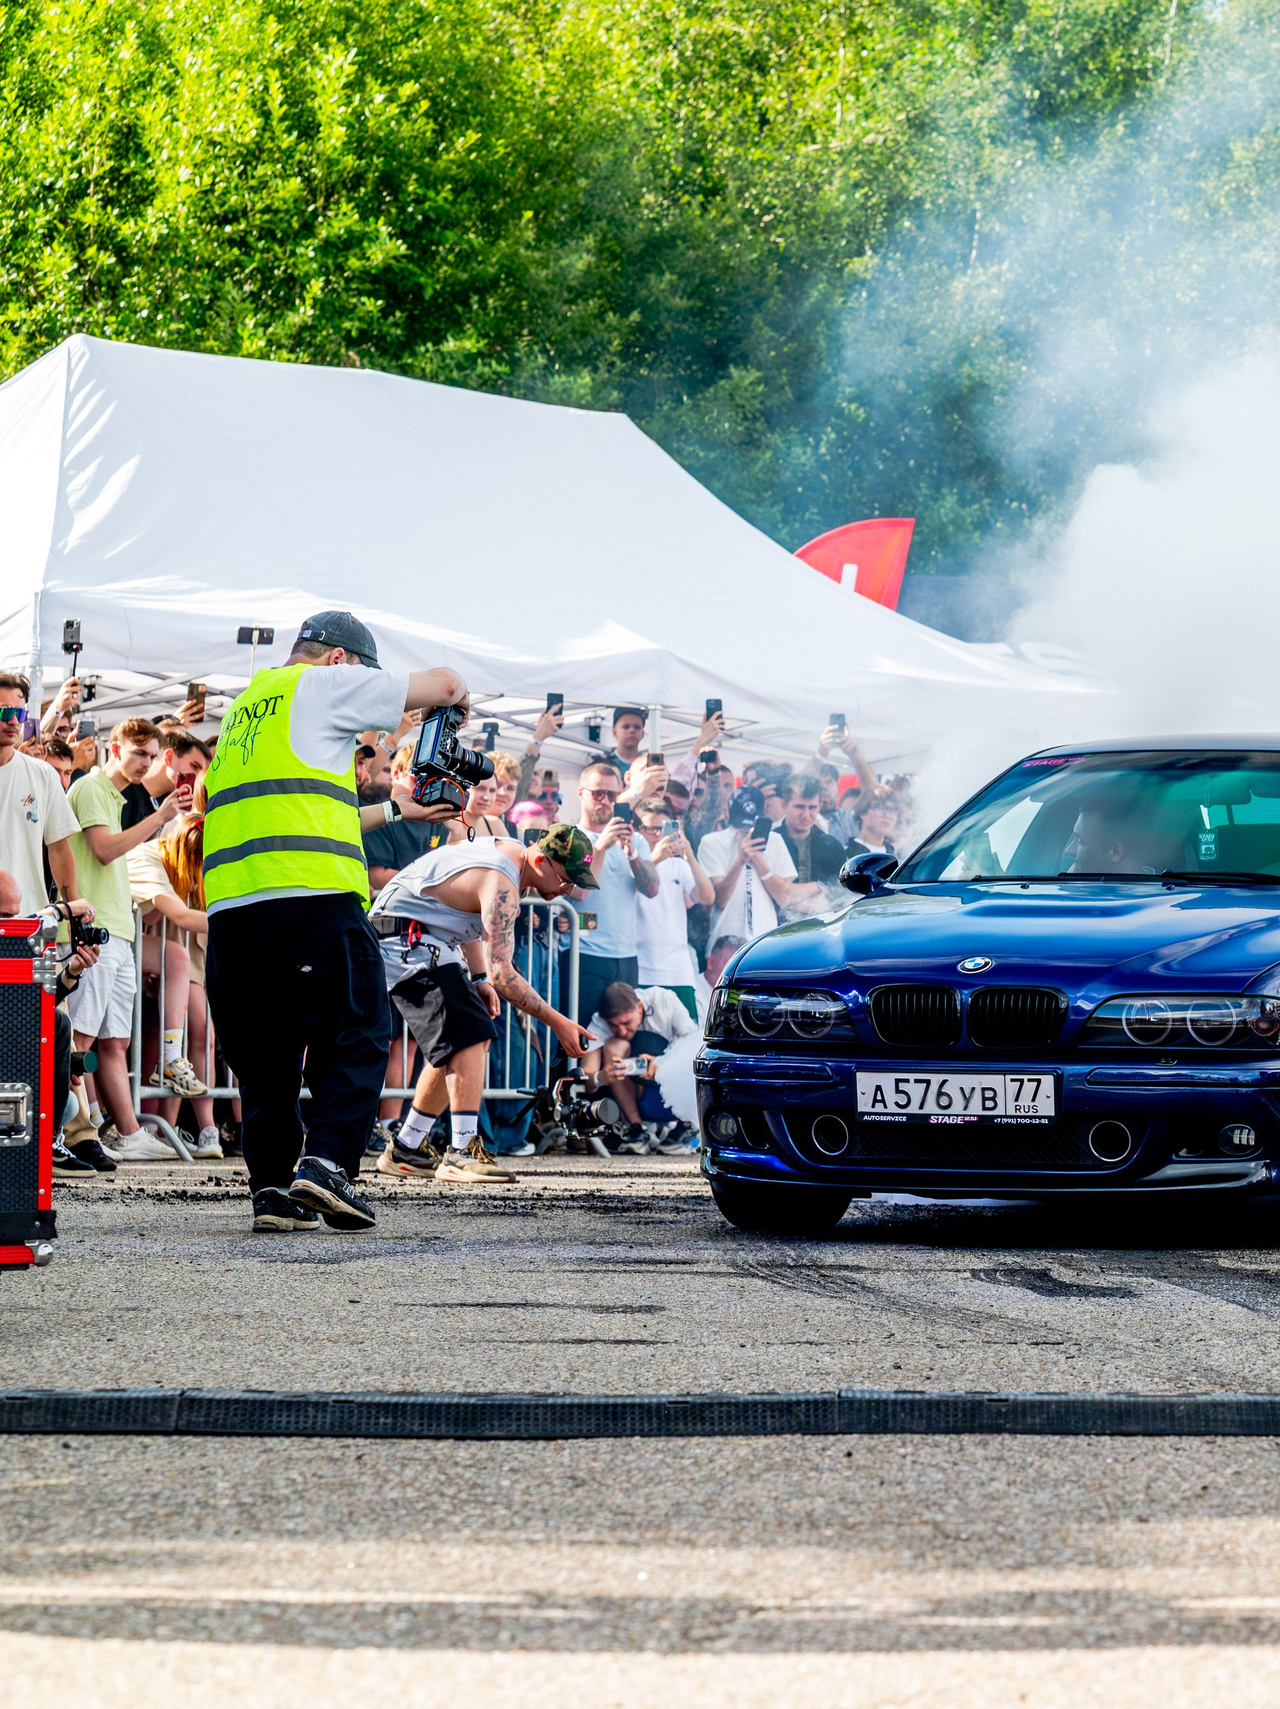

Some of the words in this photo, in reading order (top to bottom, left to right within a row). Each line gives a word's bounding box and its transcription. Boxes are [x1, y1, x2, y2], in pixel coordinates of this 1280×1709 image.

[870, 1077, 998, 1112] А576УВ
[1009, 1077, 1042, 1103] 77
[1014, 1104, 1039, 1114] RUS
[929, 1115, 964, 1124] STAGE
